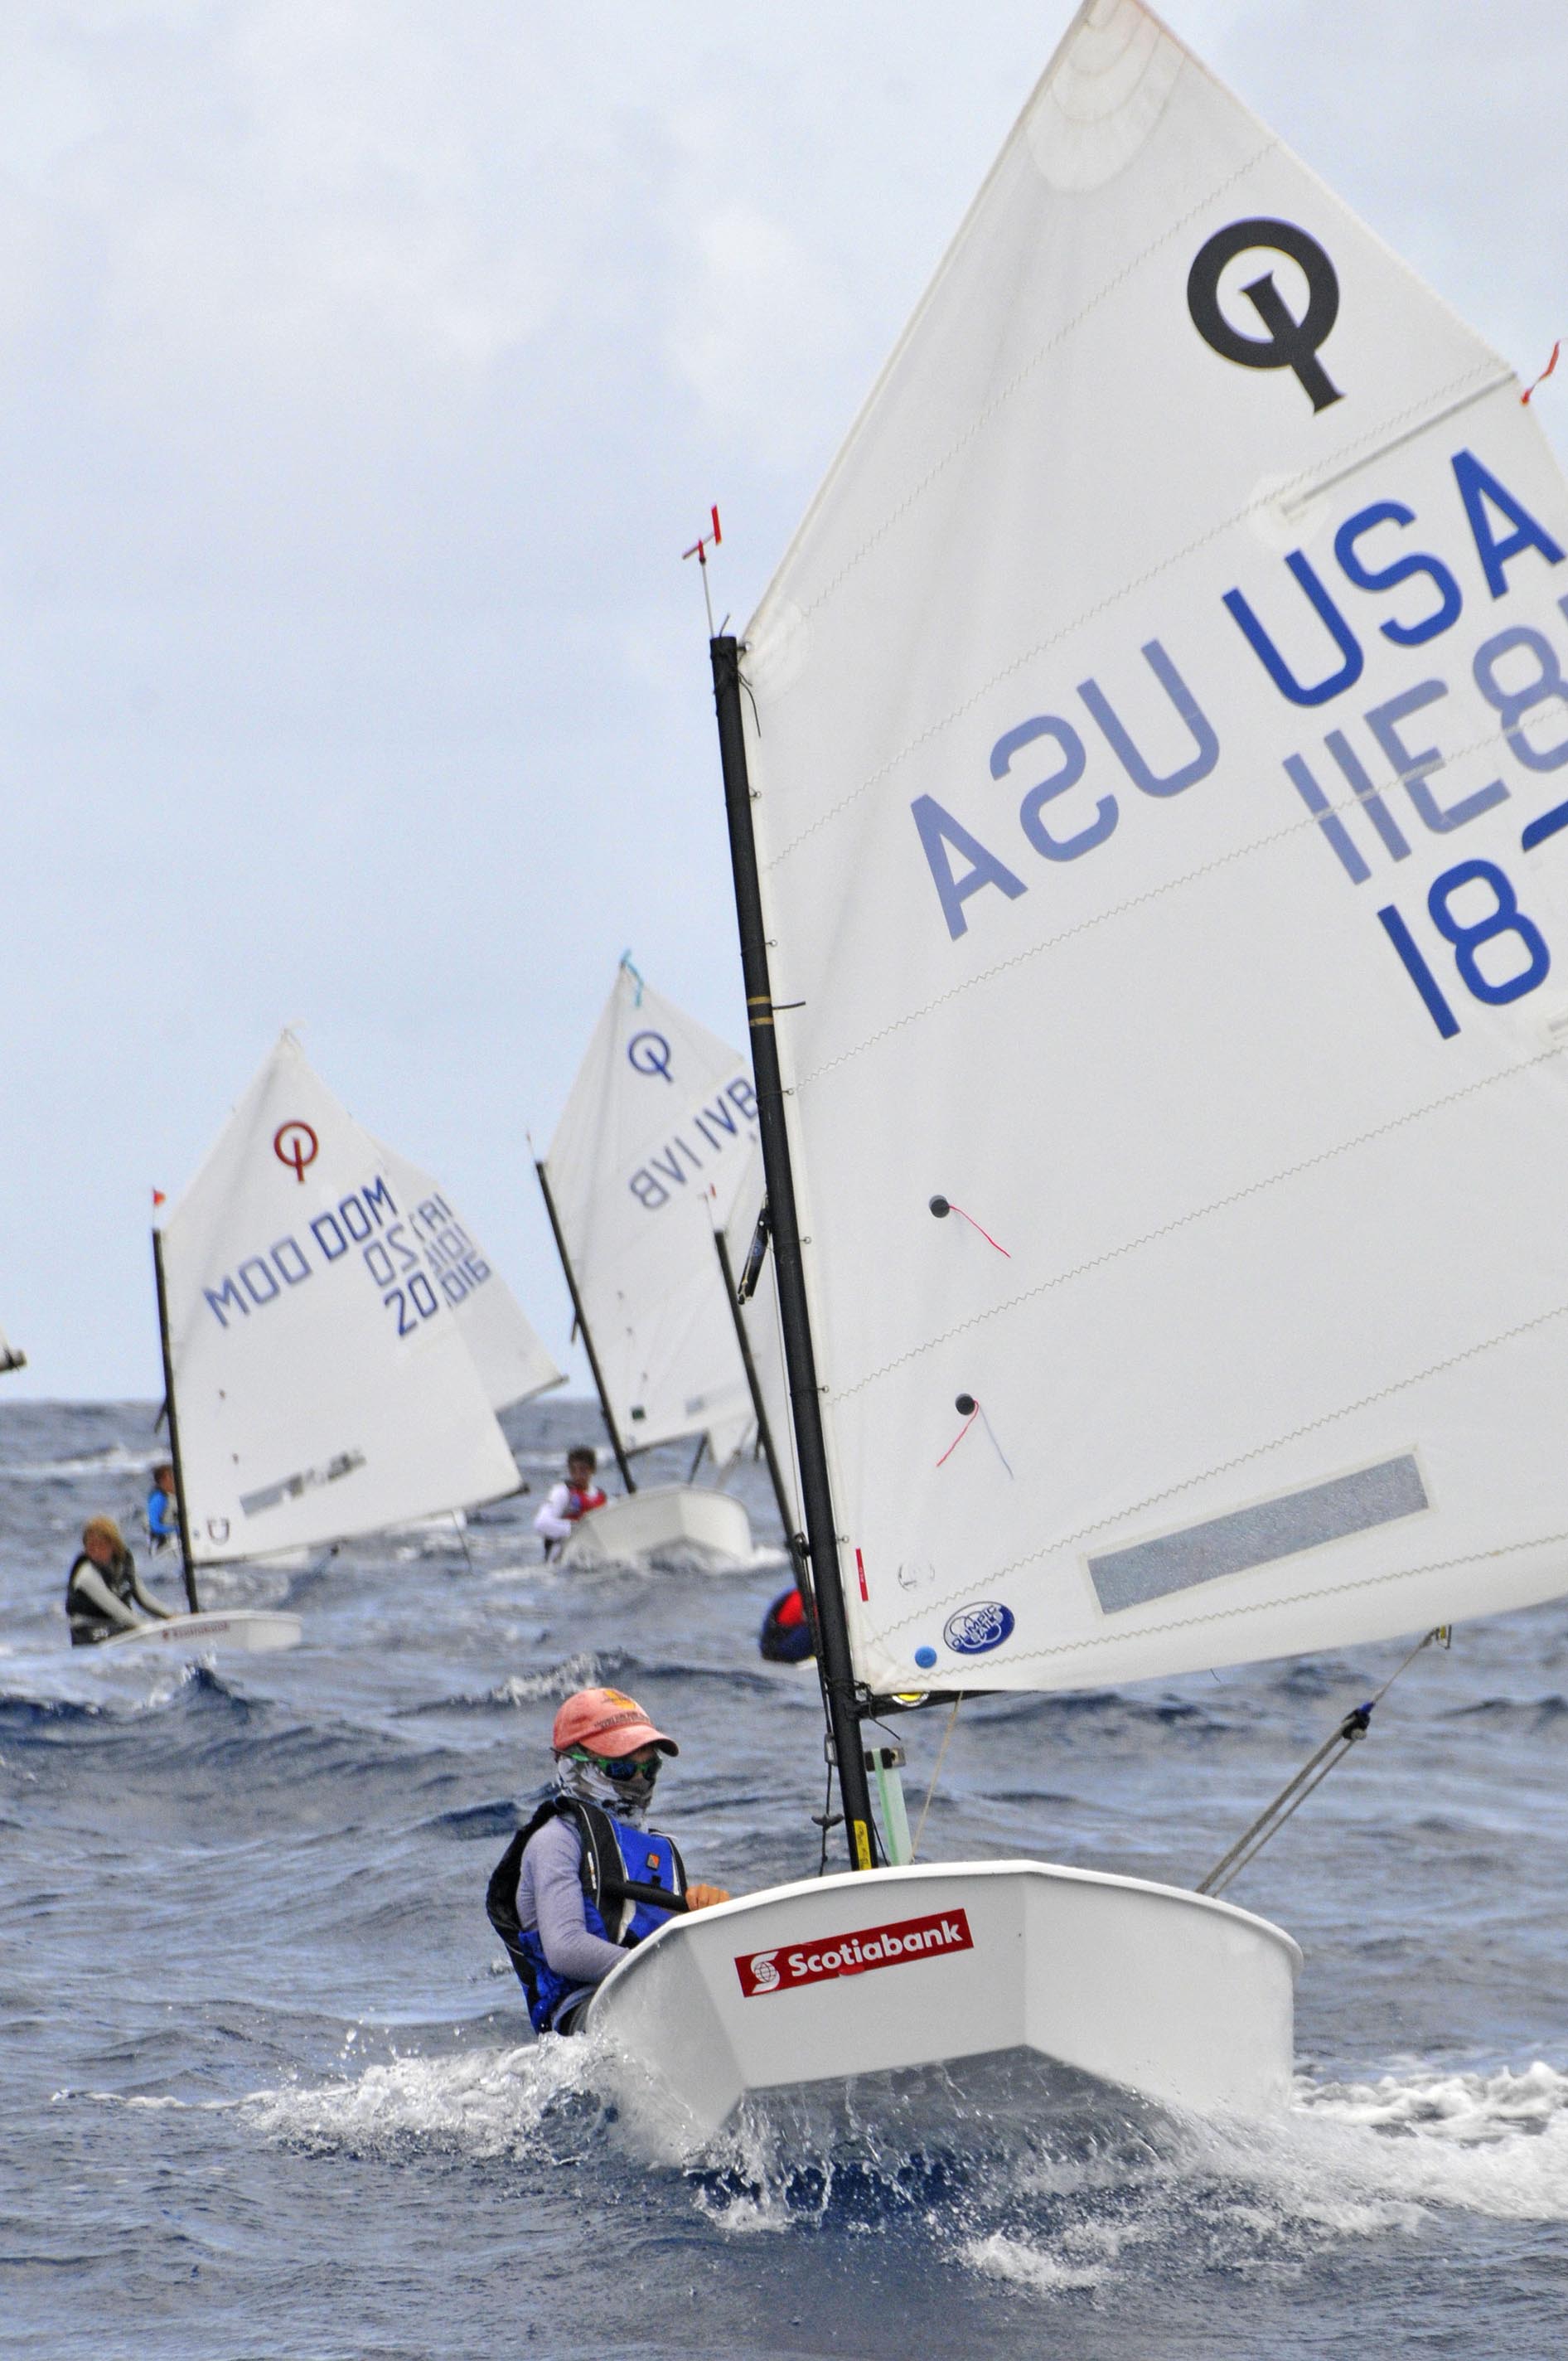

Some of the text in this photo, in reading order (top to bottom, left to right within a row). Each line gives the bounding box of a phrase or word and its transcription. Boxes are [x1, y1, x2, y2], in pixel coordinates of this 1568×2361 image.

[1222, 448, 1566, 708] USA
[309, 1175, 399, 1262] DOM
[384, 1268, 439, 1337] 20
[787, 1919, 964, 1977] Scotiabank
